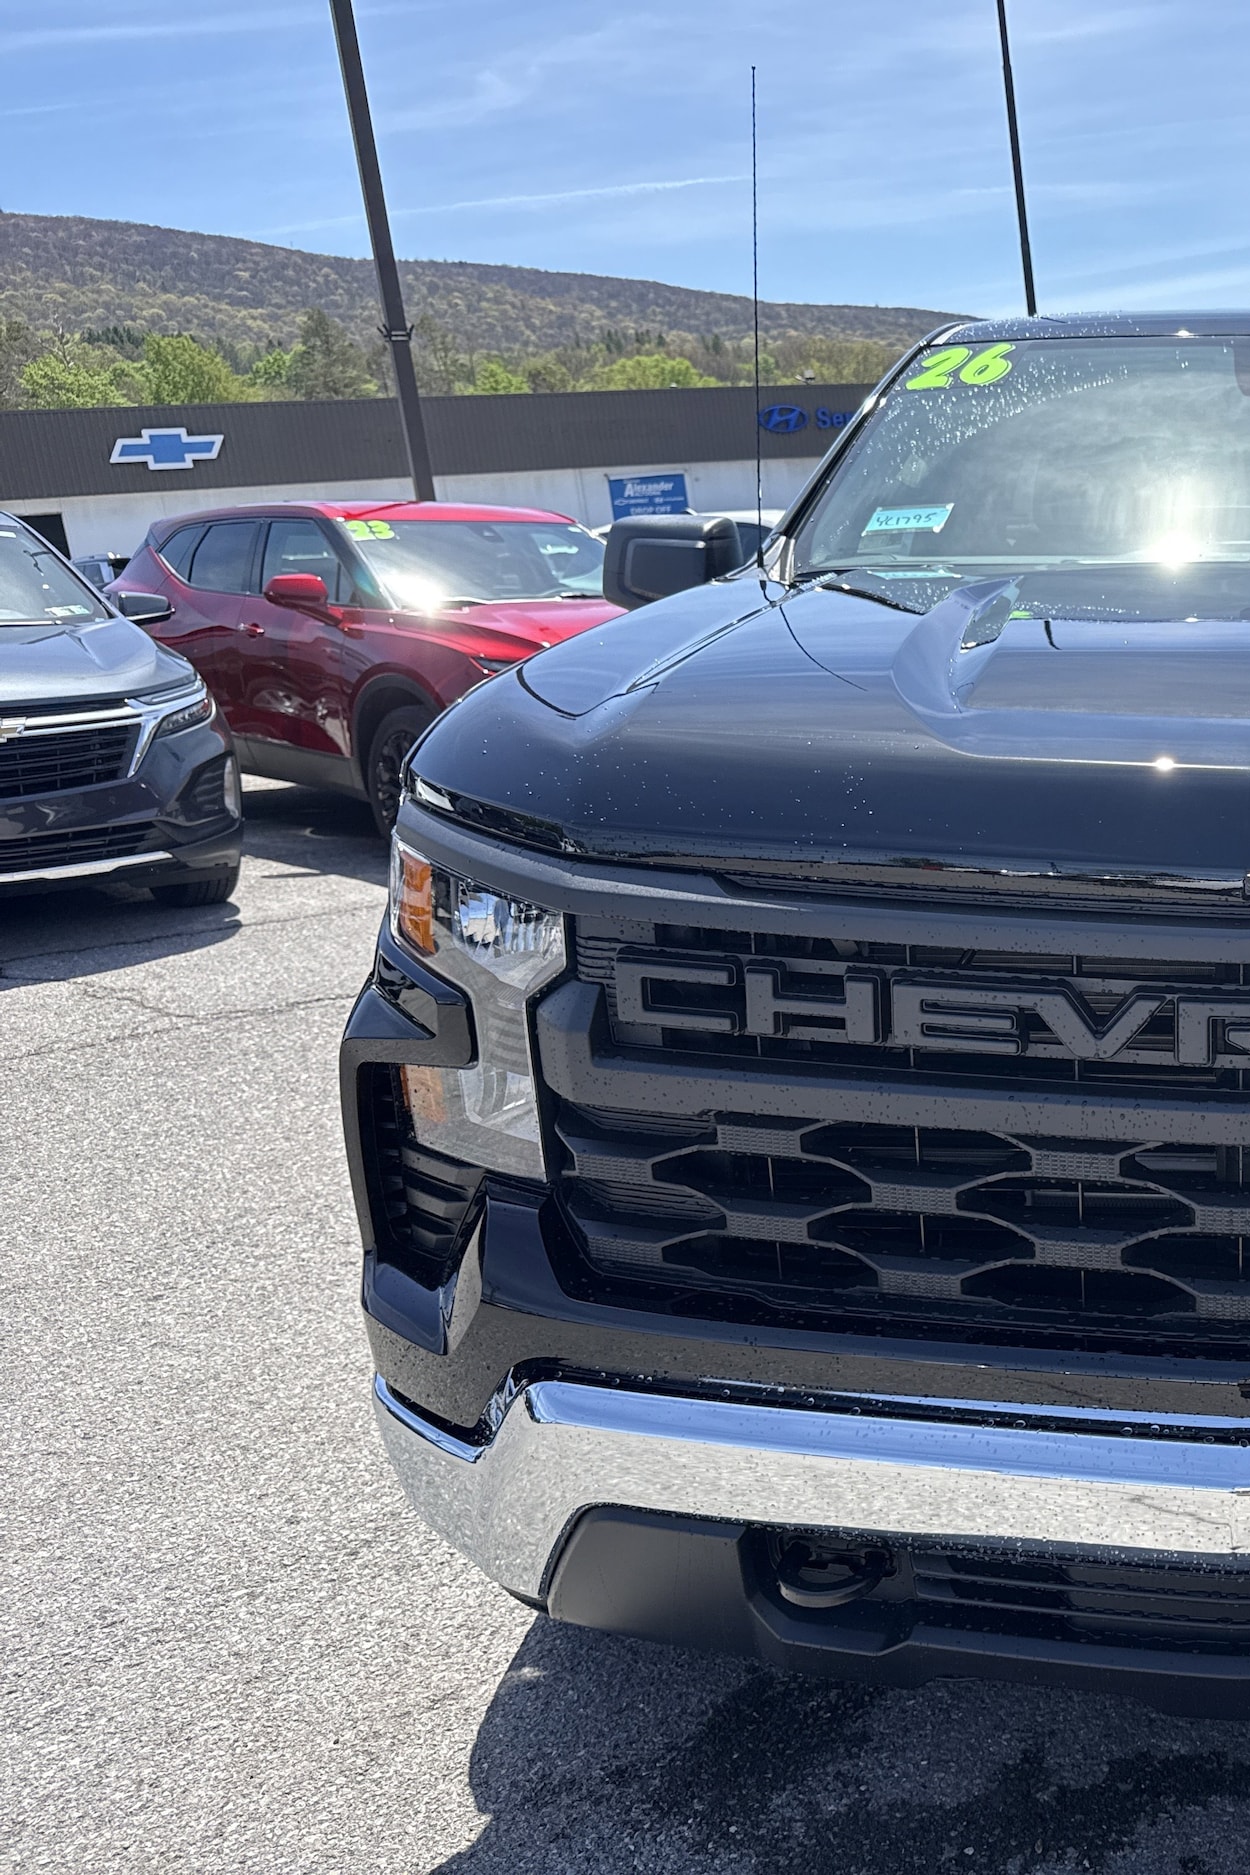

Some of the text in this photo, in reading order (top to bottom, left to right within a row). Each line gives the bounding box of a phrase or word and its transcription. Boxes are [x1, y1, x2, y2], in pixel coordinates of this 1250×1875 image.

[905, 343, 1017, 391] 26
[623, 482, 674, 497] Alexander
[655, 505, 672, 514] OFF
[345, 520, 395, 541] 23
